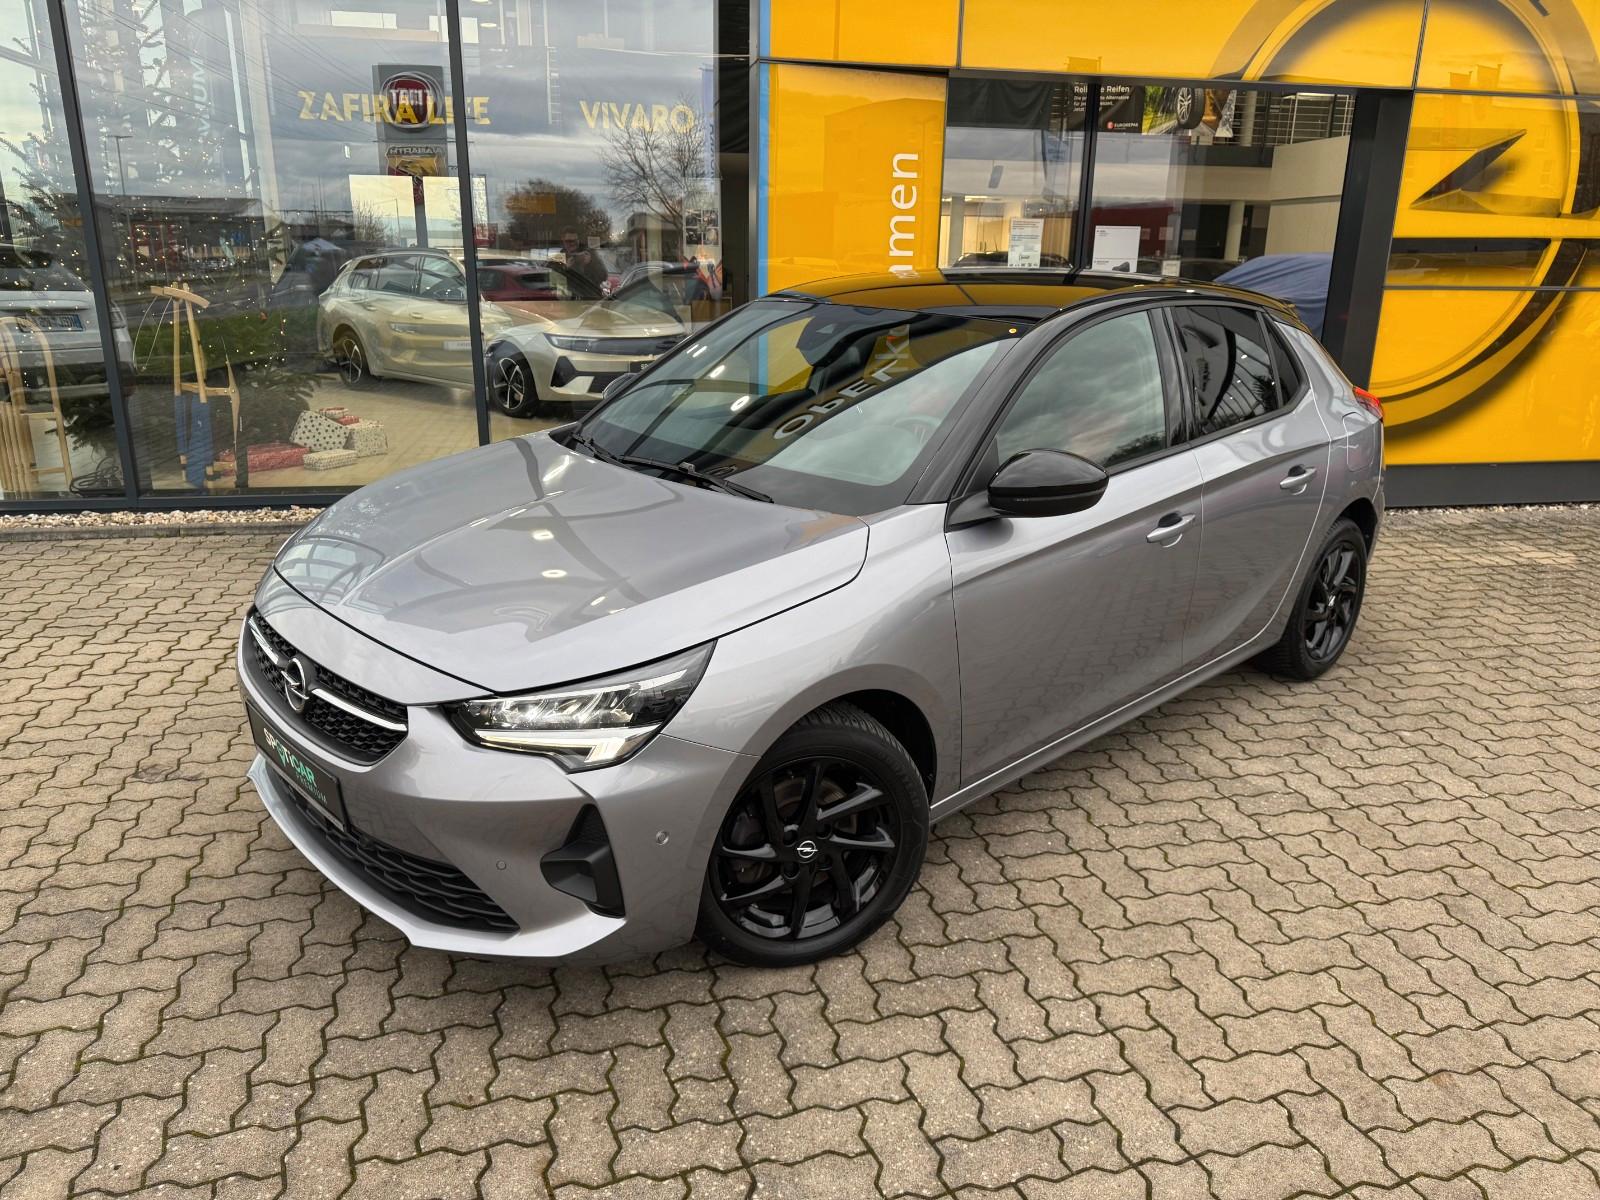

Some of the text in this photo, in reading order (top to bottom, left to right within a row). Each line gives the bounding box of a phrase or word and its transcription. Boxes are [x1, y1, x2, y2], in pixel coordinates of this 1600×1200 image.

[1106, 85, 1130, 93] Reifen
[298, 90, 491, 125] ZAFIRA LIE
[579, 100, 695, 134] VIVARO
